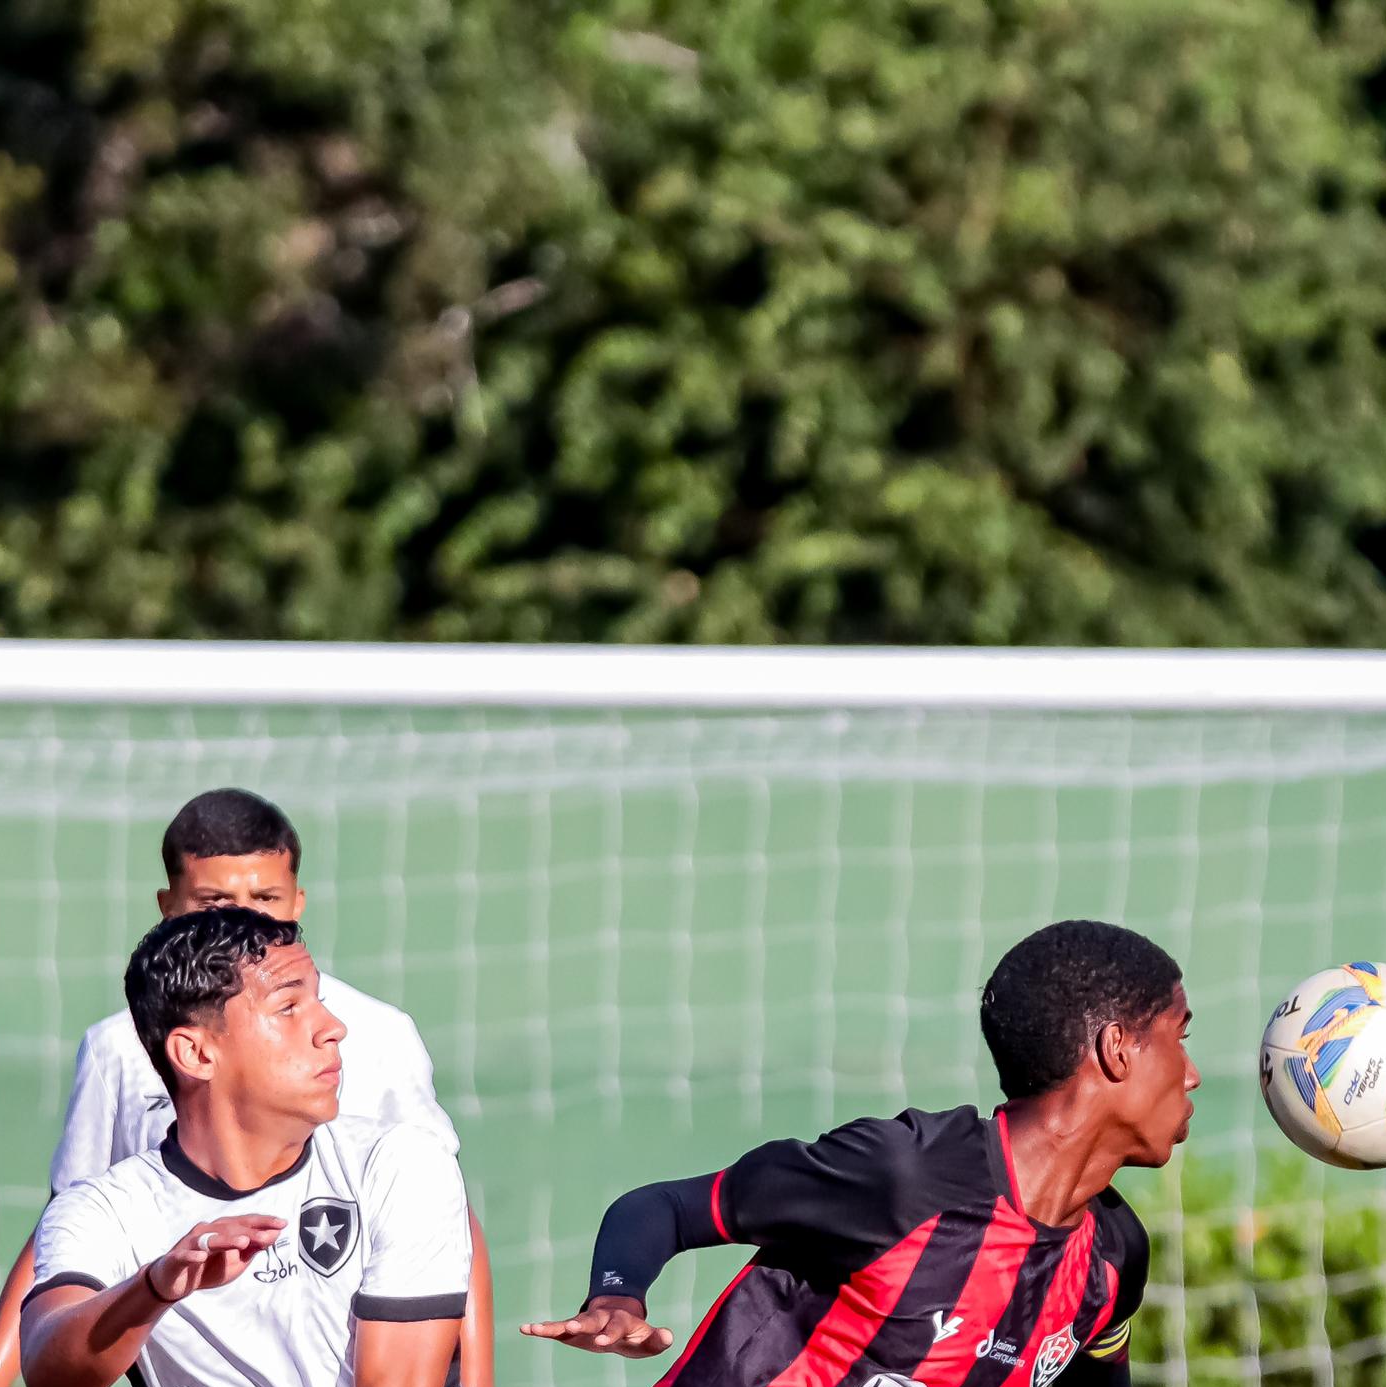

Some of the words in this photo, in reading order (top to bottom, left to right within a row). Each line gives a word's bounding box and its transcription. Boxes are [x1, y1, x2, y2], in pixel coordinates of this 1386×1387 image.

[1344, 1069, 1361, 1106] PRO
[1356, 1057, 1376, 1098] SAMBA
[1368, 1057, 1384, 1089] AMPO
[993, 1339, 1017, 1353] Jaime
